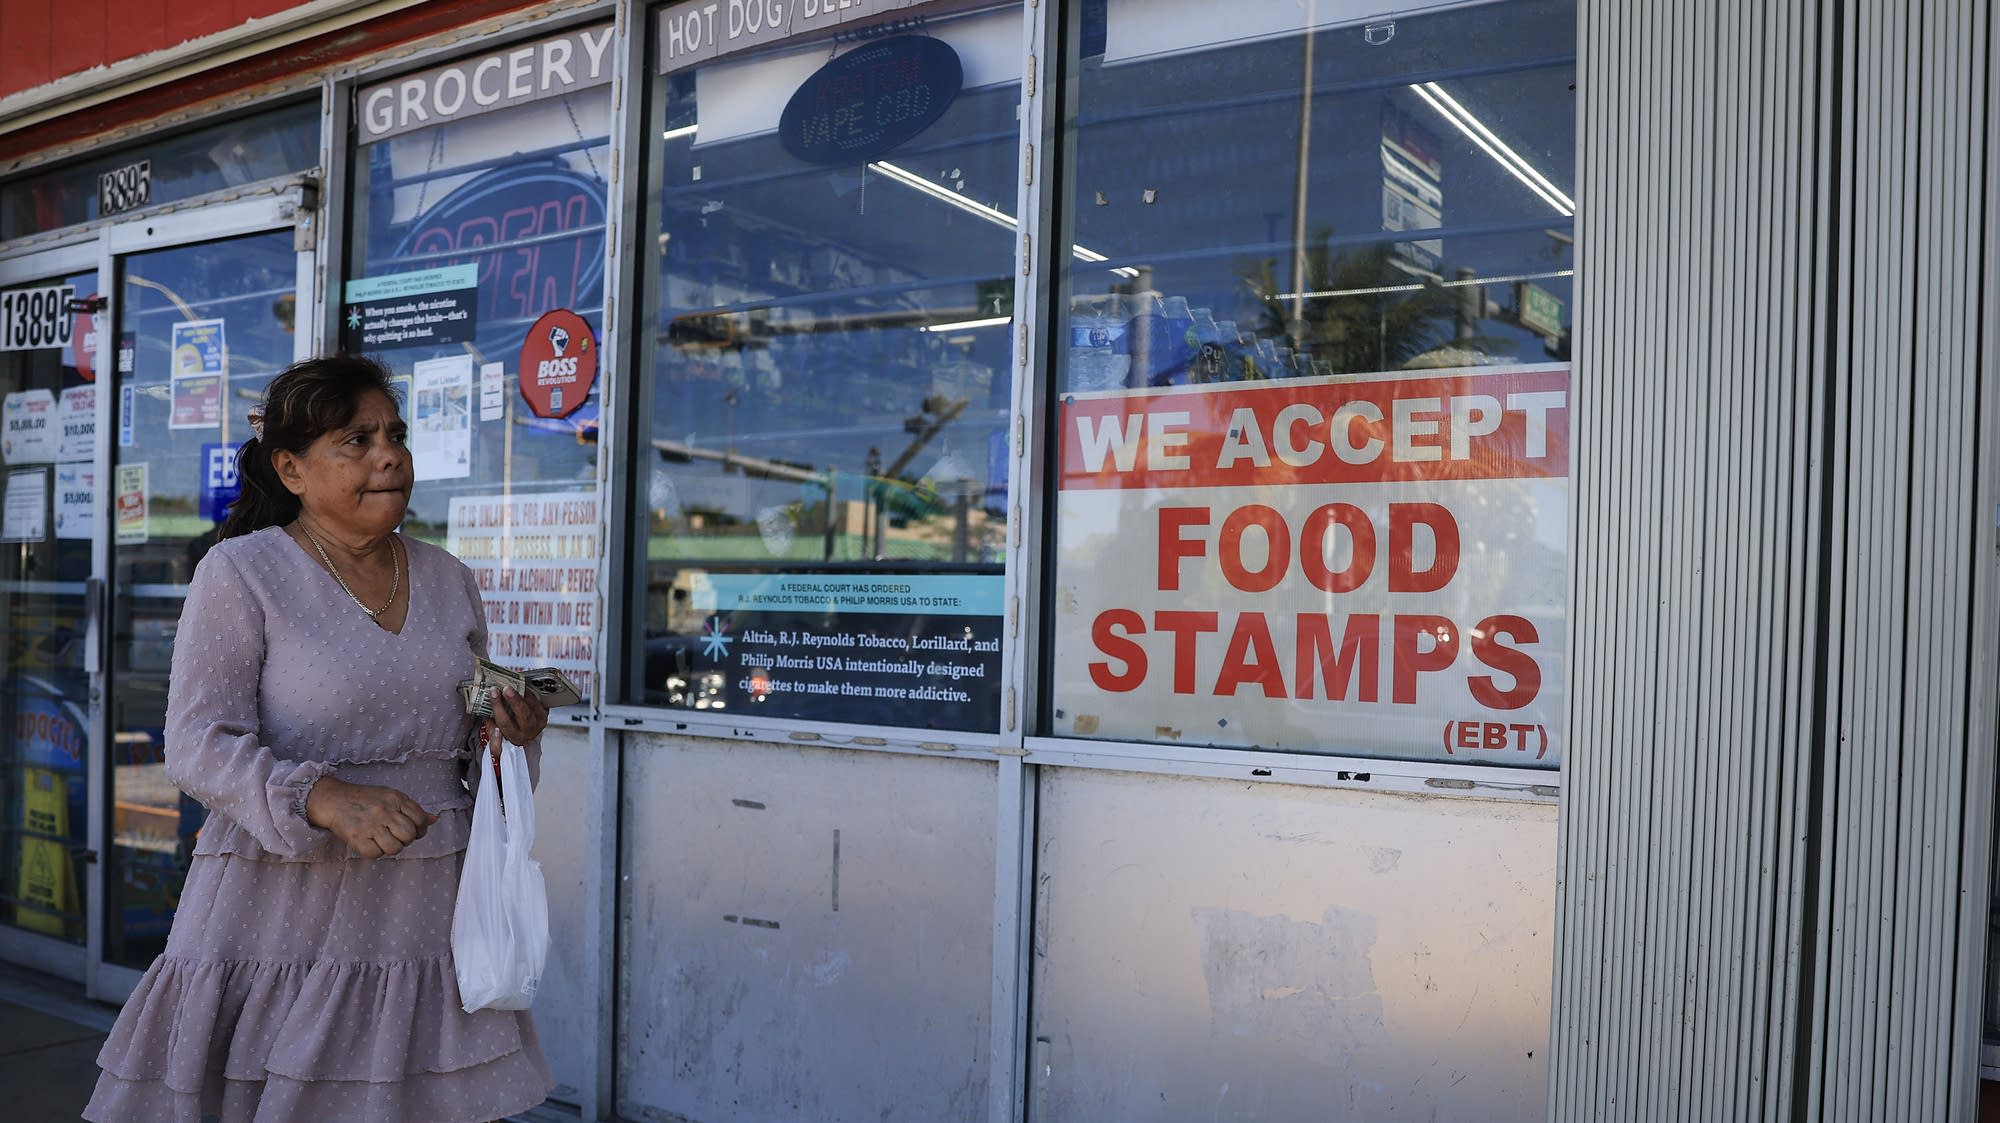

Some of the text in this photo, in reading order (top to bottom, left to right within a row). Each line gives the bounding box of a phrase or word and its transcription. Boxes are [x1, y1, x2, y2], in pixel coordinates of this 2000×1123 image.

[668, 3, 718, 58] HOT
[365, 26, 614, 135] GROCERY
[876, 84, 931, 126] CBD
[802, 103, 864, 147] VAPE
[4, 288, 73, 347] 13895
[365, 307, 383, 317] When
[418, 301, 429, 310] the
[430, 298, 456, 309] nicotine
[388, 318, 414, 328] changes
[414, 314, 425, 324] the
[537, 357, 578, 378] BOSS
[537, 375, 577, 386] REVOLUTION
[1075, 390, 1568, 474] WE ACCEPT
[208, 448, 238, 488] EB
[524, 502, 539, 527] FOR
[541, 502, 560, 526] ANY
[562, 500, 596, 526] PERSON
[1157, 502, 1461, 594] FOOD
[518, 568, 564, 592] ALCOHOLIC
[781, 584, 911, 593] A FEDERAL COURT HAS ORDERED
[508, 601, 519, 624] OR
[523, 601, 553, 625] WITHIN
[557, 601, 572, 626] 100
[753, 594, 793, 604] REYNOLDS
[794, 595, 831, 604] TOBACCO
[833, 596, 839, 605] &
[840, 596, 866, 605] PHILIP
[867, 596, 899, 606] MORRIS
[900, 597, 918, 606] USA
[919, 597, 931, 607] TO
[932, 598, 962, 607] STATE:
[496, 633, 513, 657] THIS
[547, 634, 593, 661] VIOLATORS
[742, 630, 1000, 654] Altria, R.J. Reynolds Tobacco, Lorillard, and
[741, 653, 985, 680] Philip Morris USA intentionally designed
[1088, 608, 1542, 710] STAMPS
[738, 676, 971, 702] cigarettes to make them more addictive.
[1443, 719, 1549, 760] (EBT)
